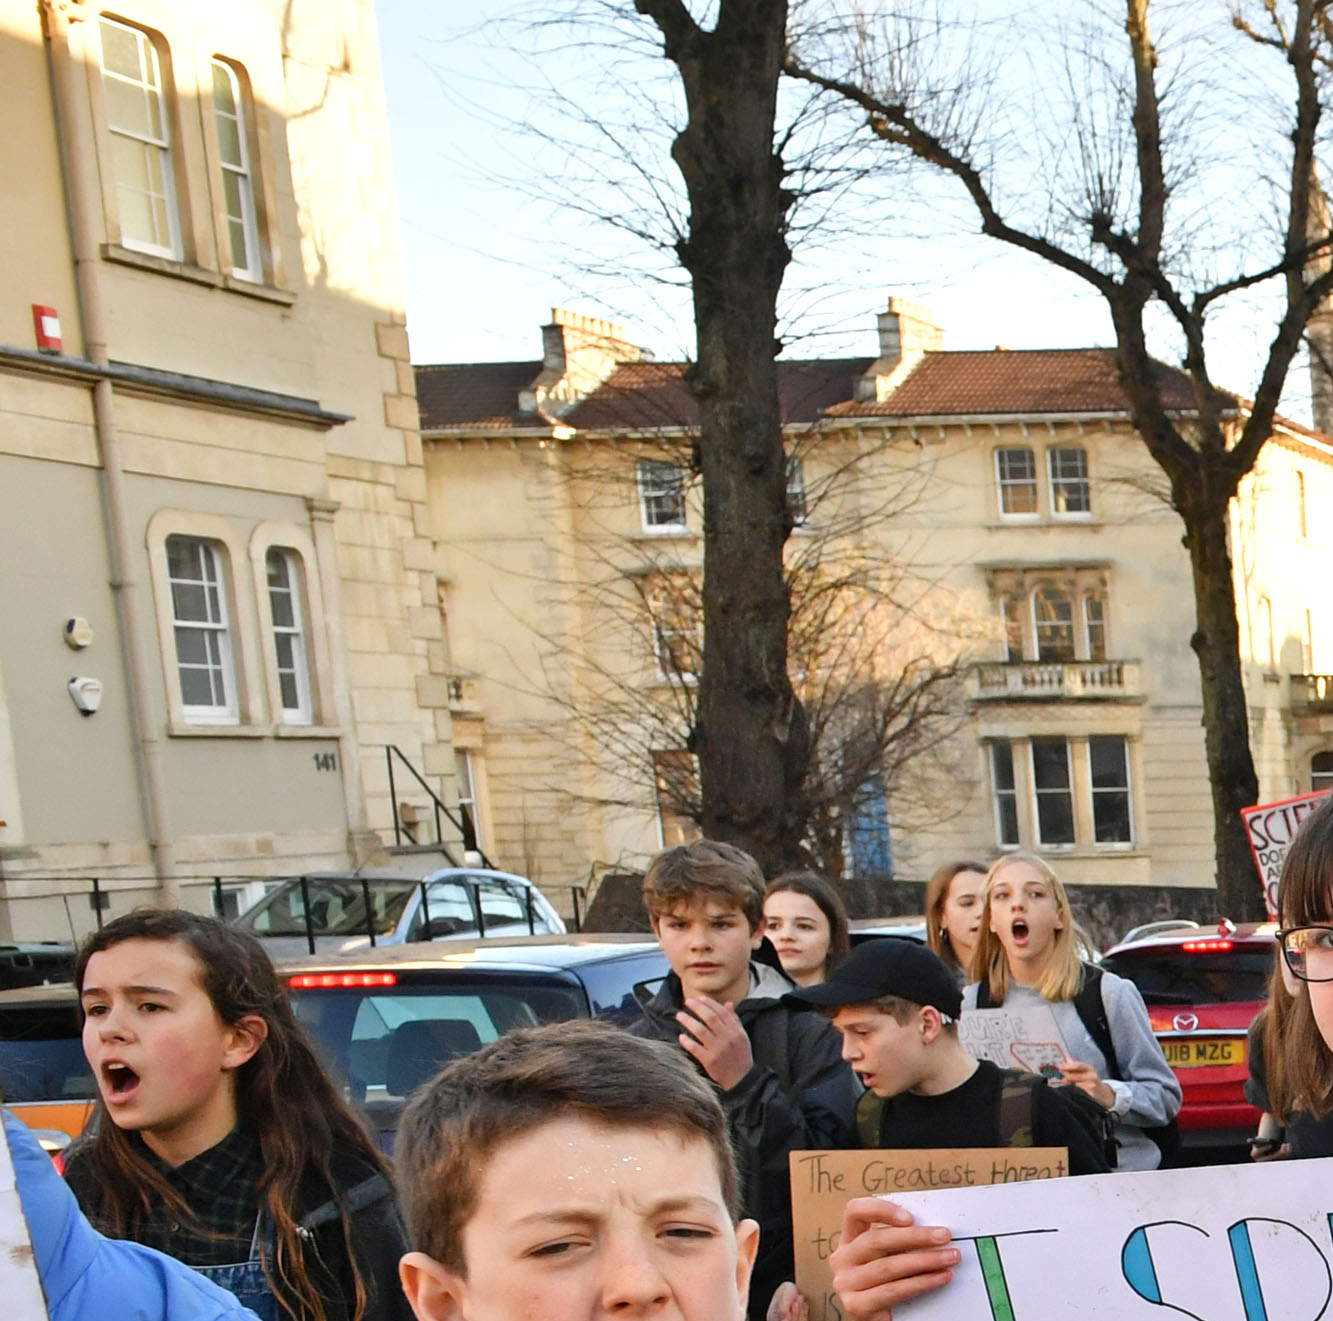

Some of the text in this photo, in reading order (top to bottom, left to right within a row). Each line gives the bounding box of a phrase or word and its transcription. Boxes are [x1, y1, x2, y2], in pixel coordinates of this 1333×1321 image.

[313, 752, 337, 772] 141
[1162, 1043, 1233, 1062] U18 MZG
[799, 1154, 1068, 1195] The Greatest threat
